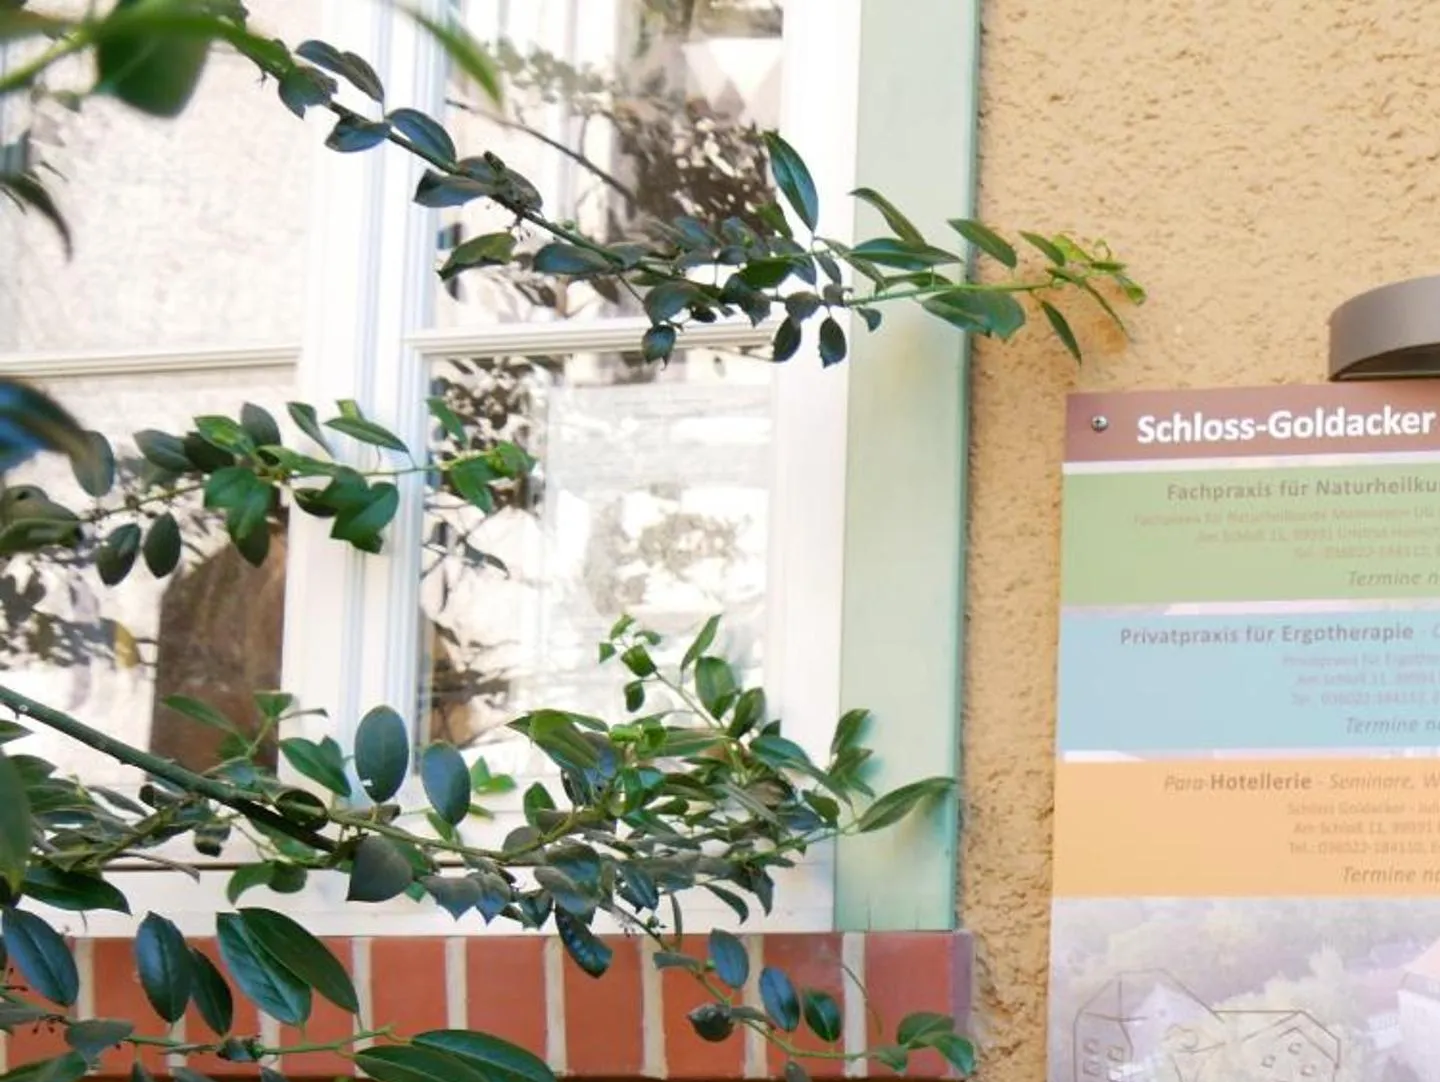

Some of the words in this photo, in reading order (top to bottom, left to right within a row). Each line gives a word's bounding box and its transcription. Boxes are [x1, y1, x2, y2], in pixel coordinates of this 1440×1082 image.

[1137, 405, 1436, 443] Schloss-Goldacker
[1167, 482, 1271, 502] Fachpraxis
[1279, 478, 1309, 497] für
[1348, 568, 1421, 587] Termine
[1120, 626, 1239, 647] Privatpraxis
[1246, 624, 1275, 643] für
[1281, 620, 1414, 646] Ergotherapie
[1346, 716, 1418, 735] Termine
[1343, 865, 1416, 884] Termine
